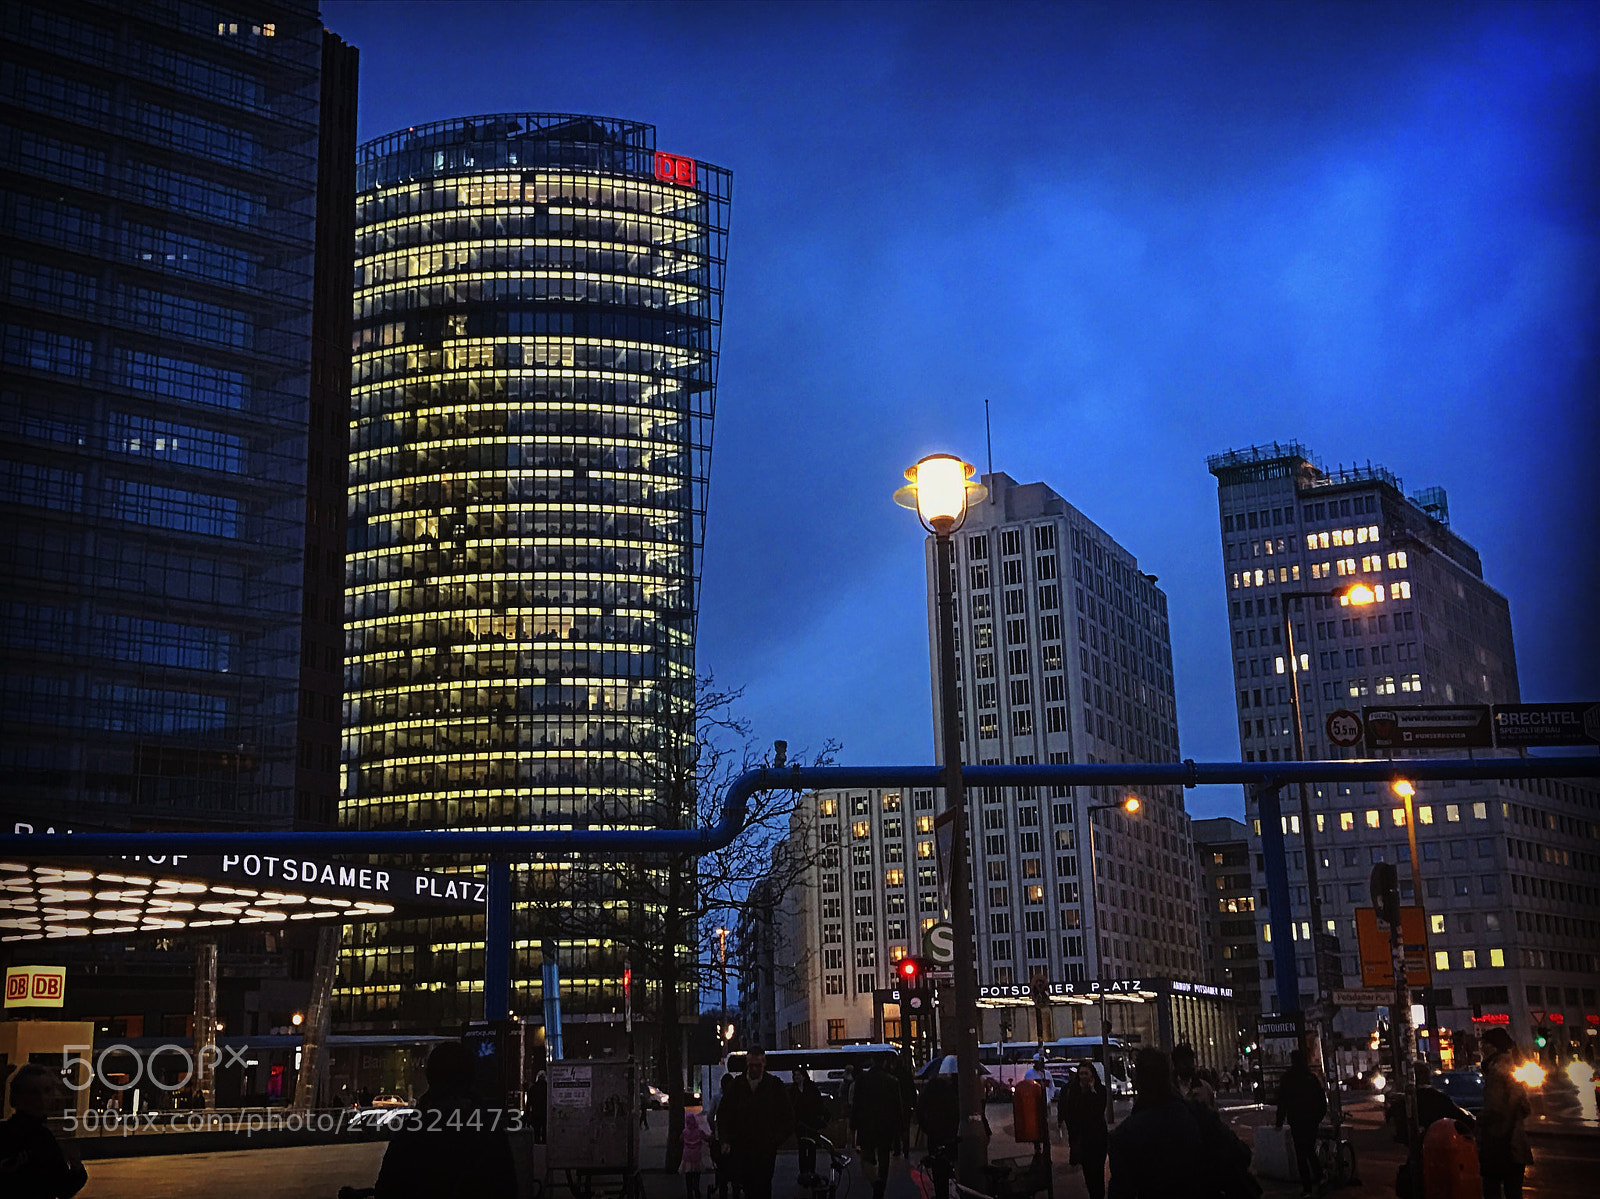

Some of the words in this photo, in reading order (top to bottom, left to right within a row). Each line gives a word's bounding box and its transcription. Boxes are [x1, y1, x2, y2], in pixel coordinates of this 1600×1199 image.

[660, 157, 690, 180] DB
[1499, 711, 1580, 725] BRECHTEL
[223, 854, 390, 891] POTSDAMER
[416, 876, 486, 902] PLATZ
[930, 926, 954, 962] S
[10, 978, 26, 996] DB
[36, 978, 58, 995] DB
[980, 984, 1074, 997] POTSDER
